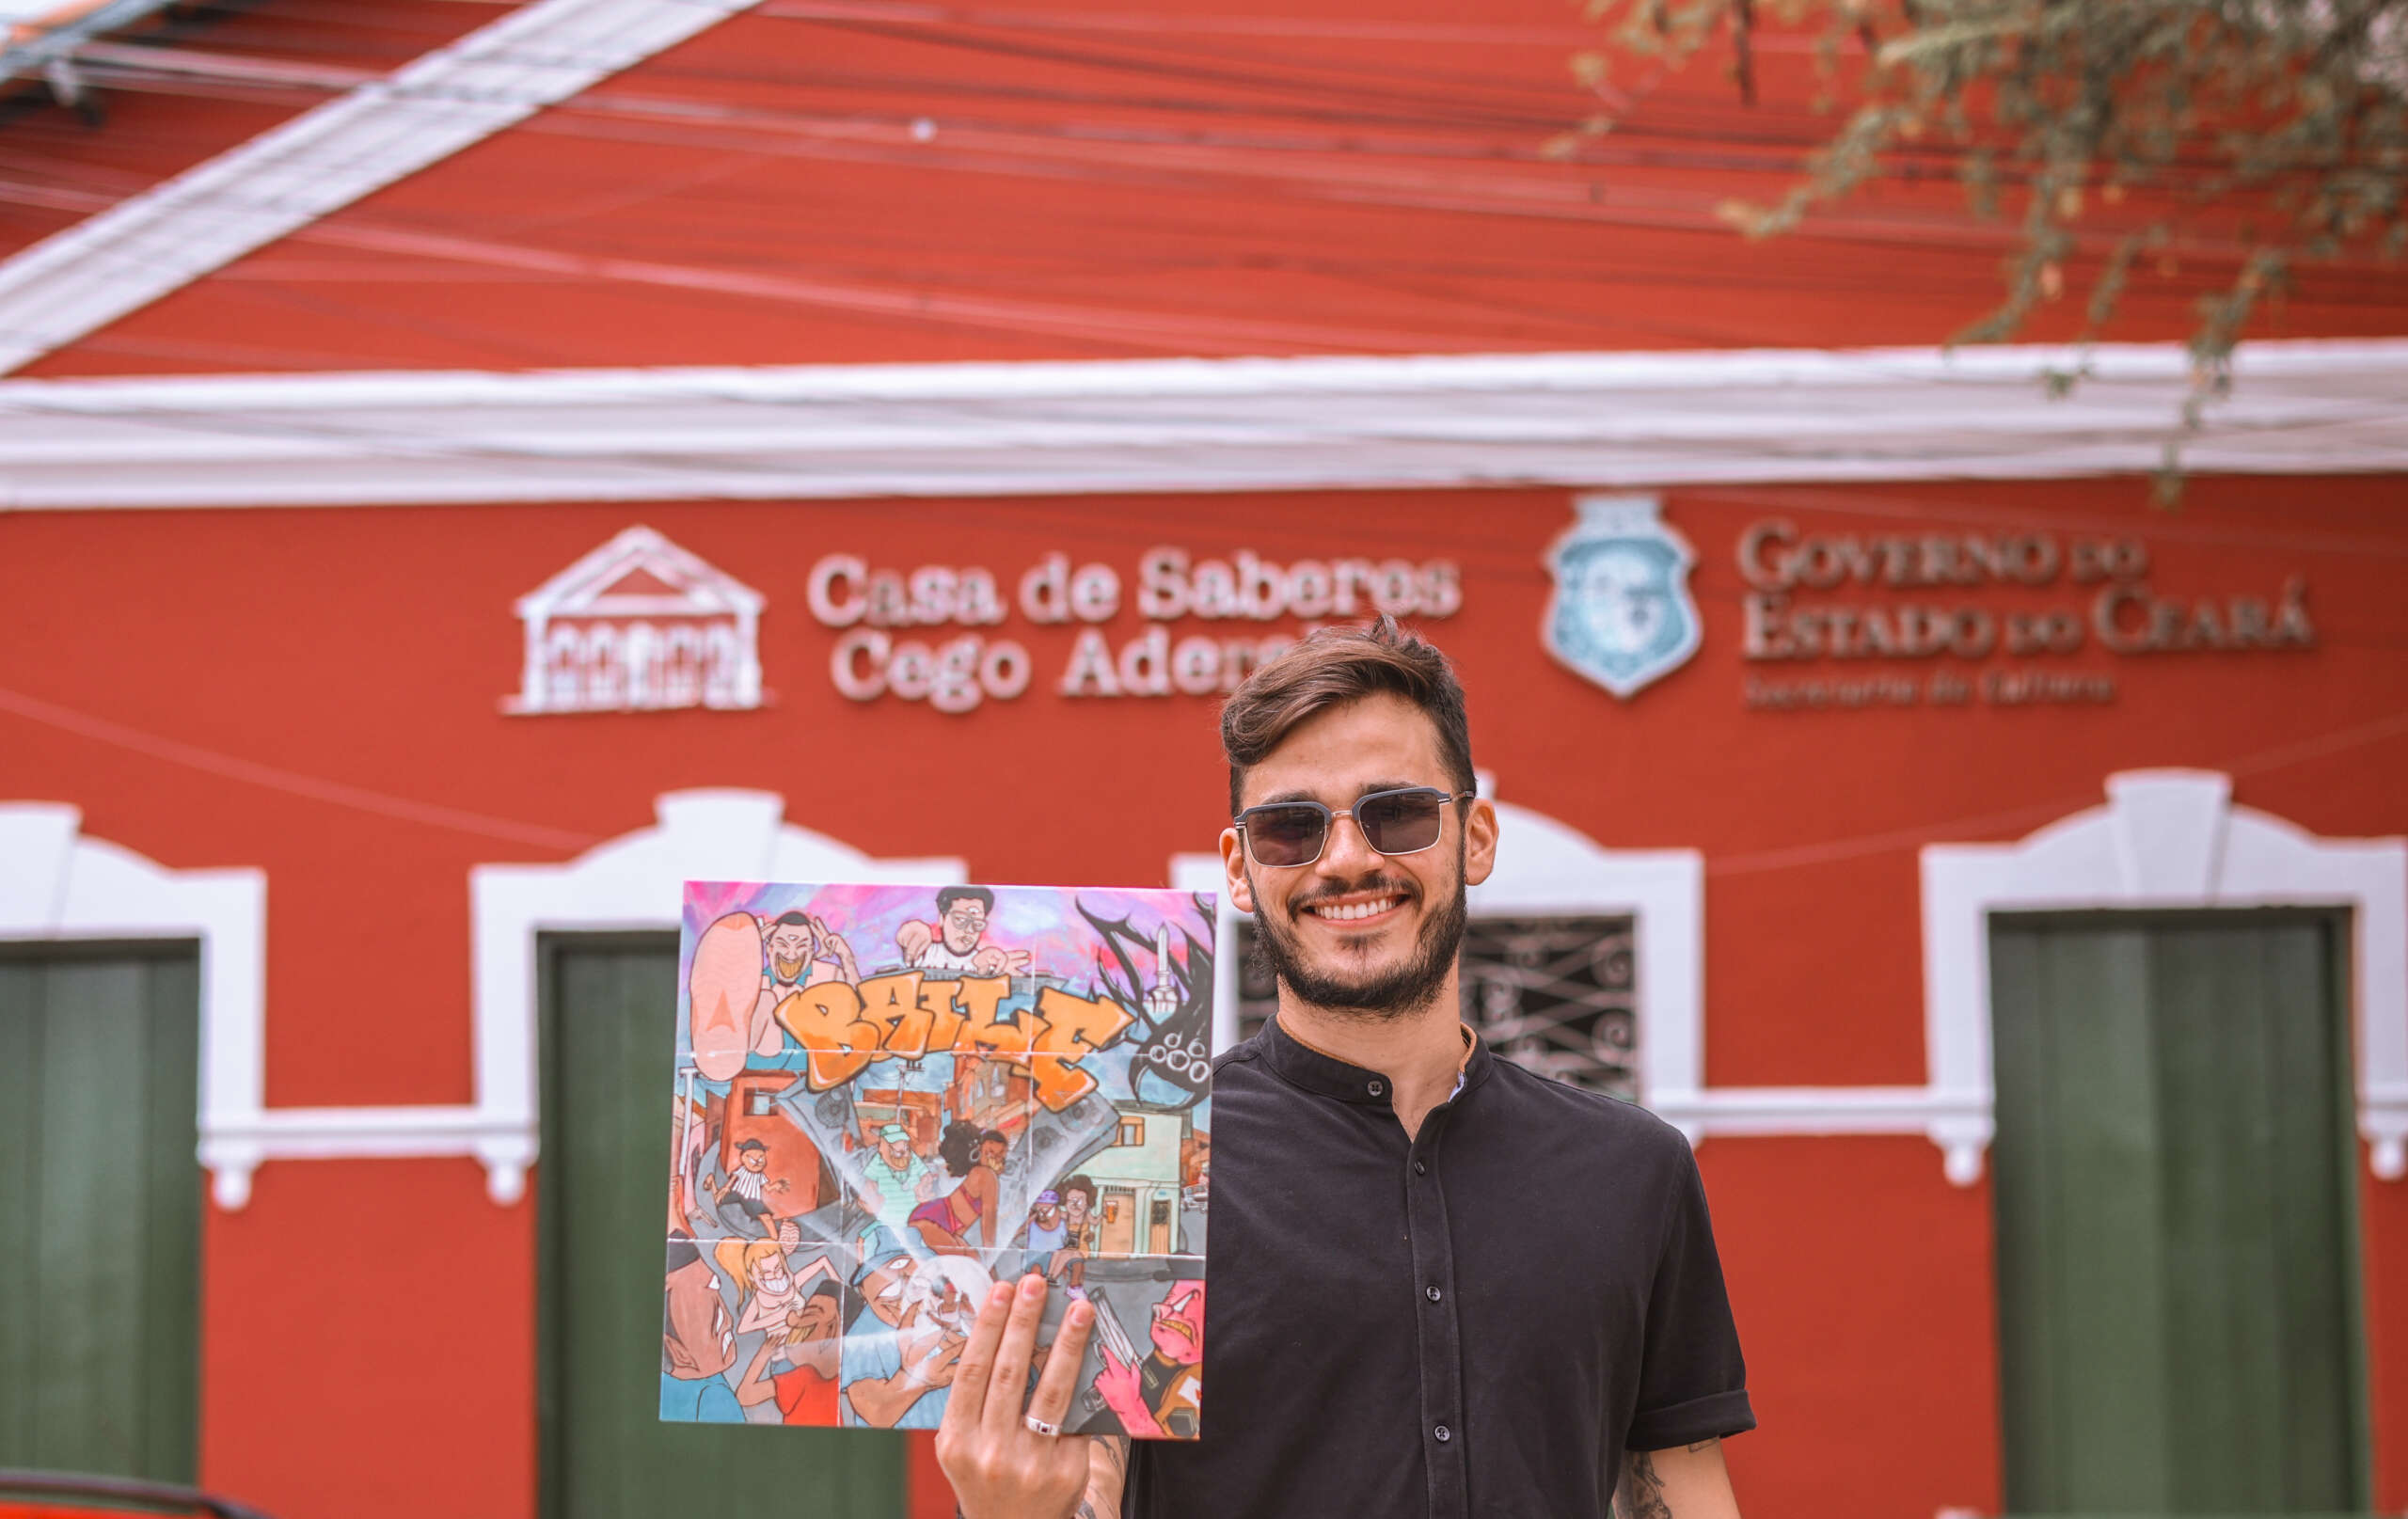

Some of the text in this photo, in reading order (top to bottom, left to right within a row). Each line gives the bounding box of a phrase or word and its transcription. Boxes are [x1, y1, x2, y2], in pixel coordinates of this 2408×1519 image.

[807, 546, 1464, 626] Casa de Saberes
[1739, 520, 2148, 587] GOVERNO DO
[1742, 574, 2318, 660] ESTADO DO CEARÁ
[830, 625, 1312, 713] Cego Ader
[774, 971, 1136, 1114] BAILE
